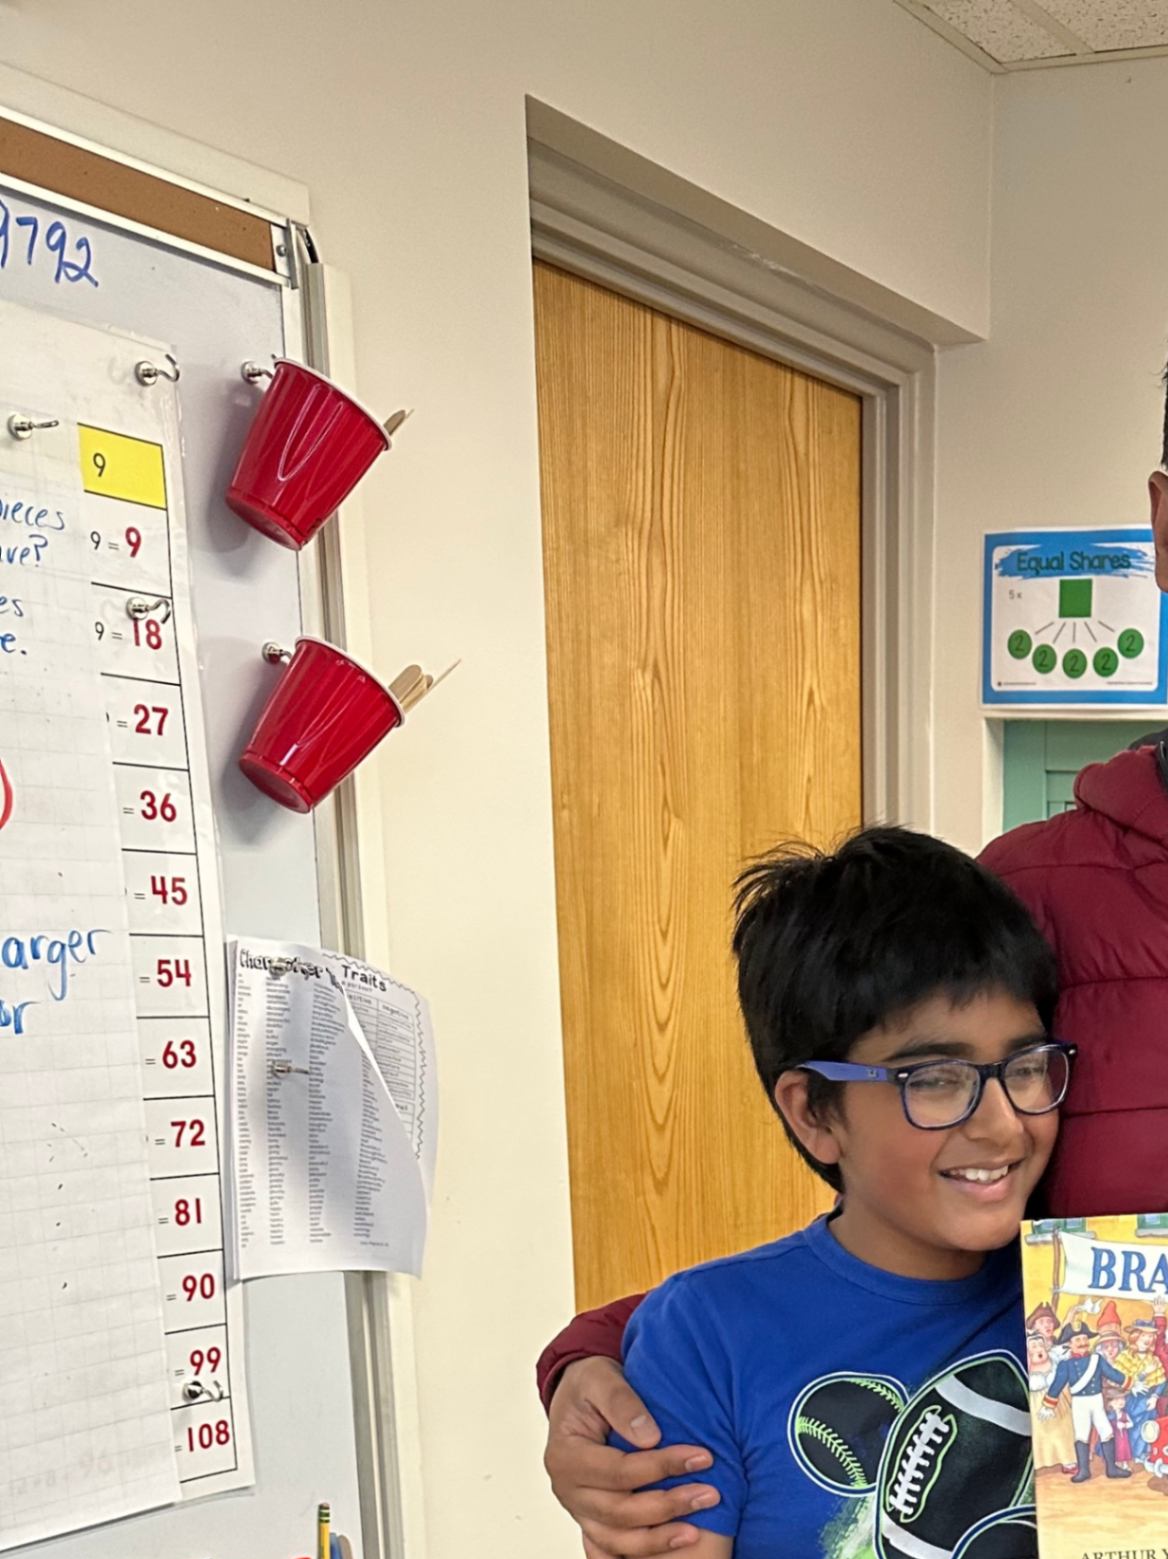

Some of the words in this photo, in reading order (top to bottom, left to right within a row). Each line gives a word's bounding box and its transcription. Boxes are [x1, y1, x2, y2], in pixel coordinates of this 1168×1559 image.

[91, 453, 107, 478] 9
[125, 527, 142, 558] 9
[1017, 551, 1064, 575] Equal
[1070, 550, 1132, 571] Shares
[132, 619, 162, 650] 18
[134, 704, 168, 736] 27
[140, 790, 177, 822] 36
[151, 876, 188, 906] 45
[157, 959, 192, 987] 54
[342, 965, 388, 992] Traits
[162, 1040, 197, 1069] 63
[171, 1119, 205, 1147] 72
[175, 1198, 202, 1226] 81
[182, 1273, 215, 1302] 90
[190, 1347, 221, 1376] 99
[188, 1420, 230, 1452] 108
